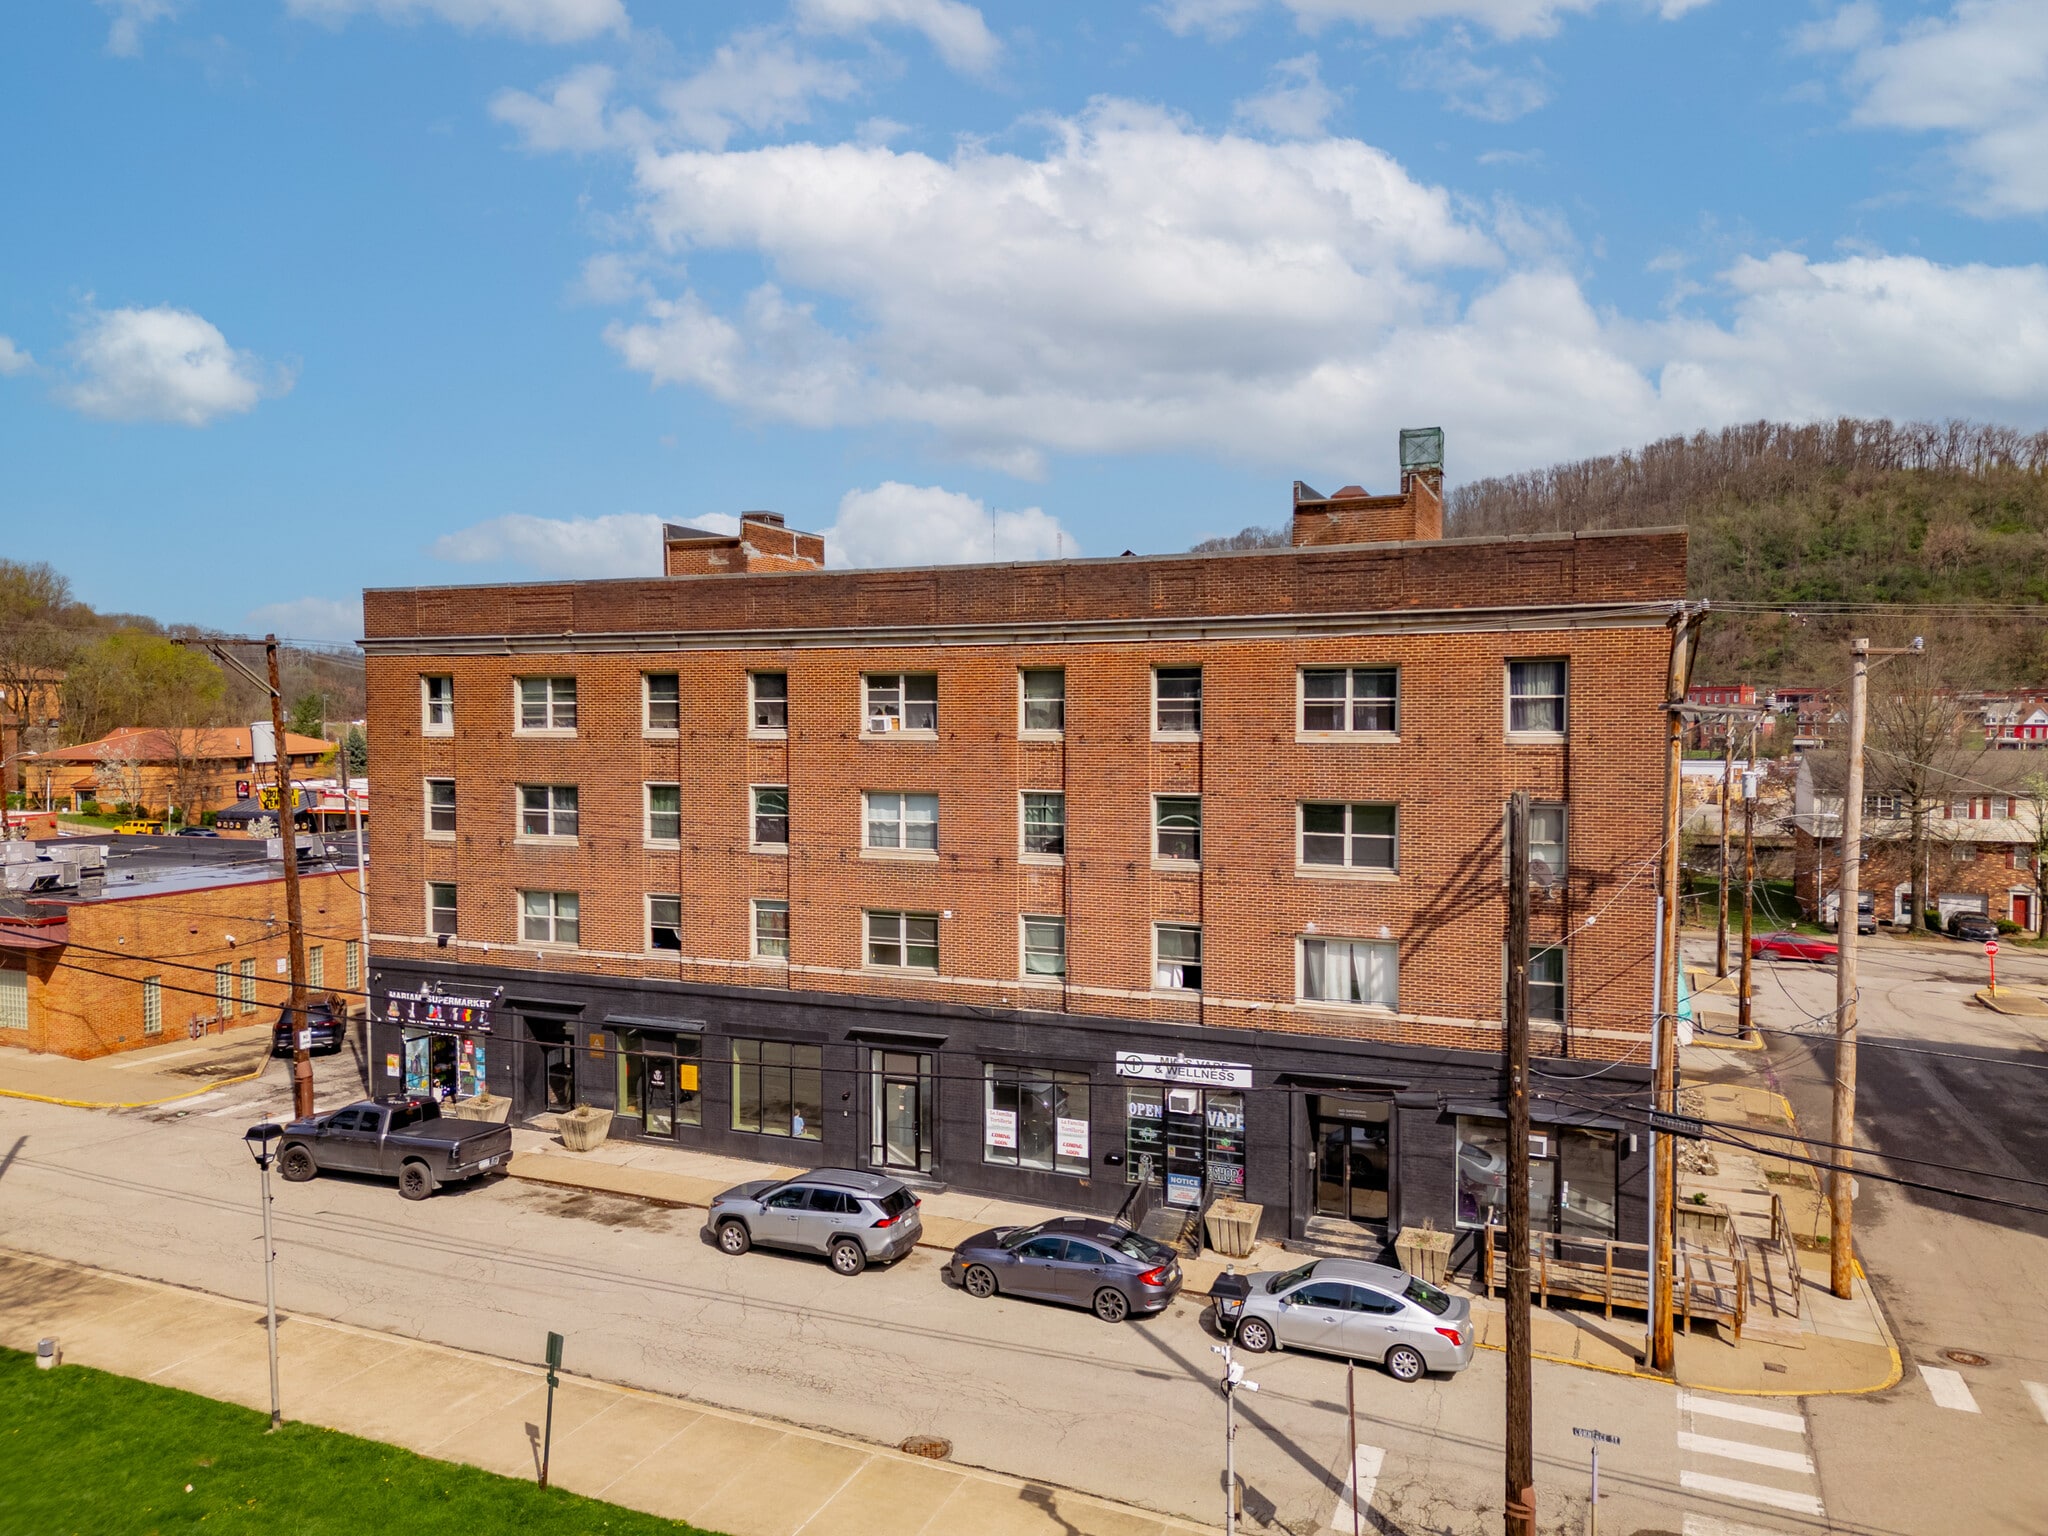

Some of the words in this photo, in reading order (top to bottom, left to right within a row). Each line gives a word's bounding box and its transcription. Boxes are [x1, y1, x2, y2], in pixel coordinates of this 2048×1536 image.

[388, 990, 422, 1001] MARIAM
[426, 995, 492, 1008] SUPERMARKET
[1154, 1065, 1163, 1074] &
[1166, 1066, 1235, 1082] WELLNESS
[1128, 1102, 1162, 1118] OPEN
[1207, 1110, 1245, 1130] VAPE
[991, 1132, 1011, 1140] COMING
[1062, 1141, 1083, 1149] COMING
[1170, 1176, 1199, 1186] NOTICE
